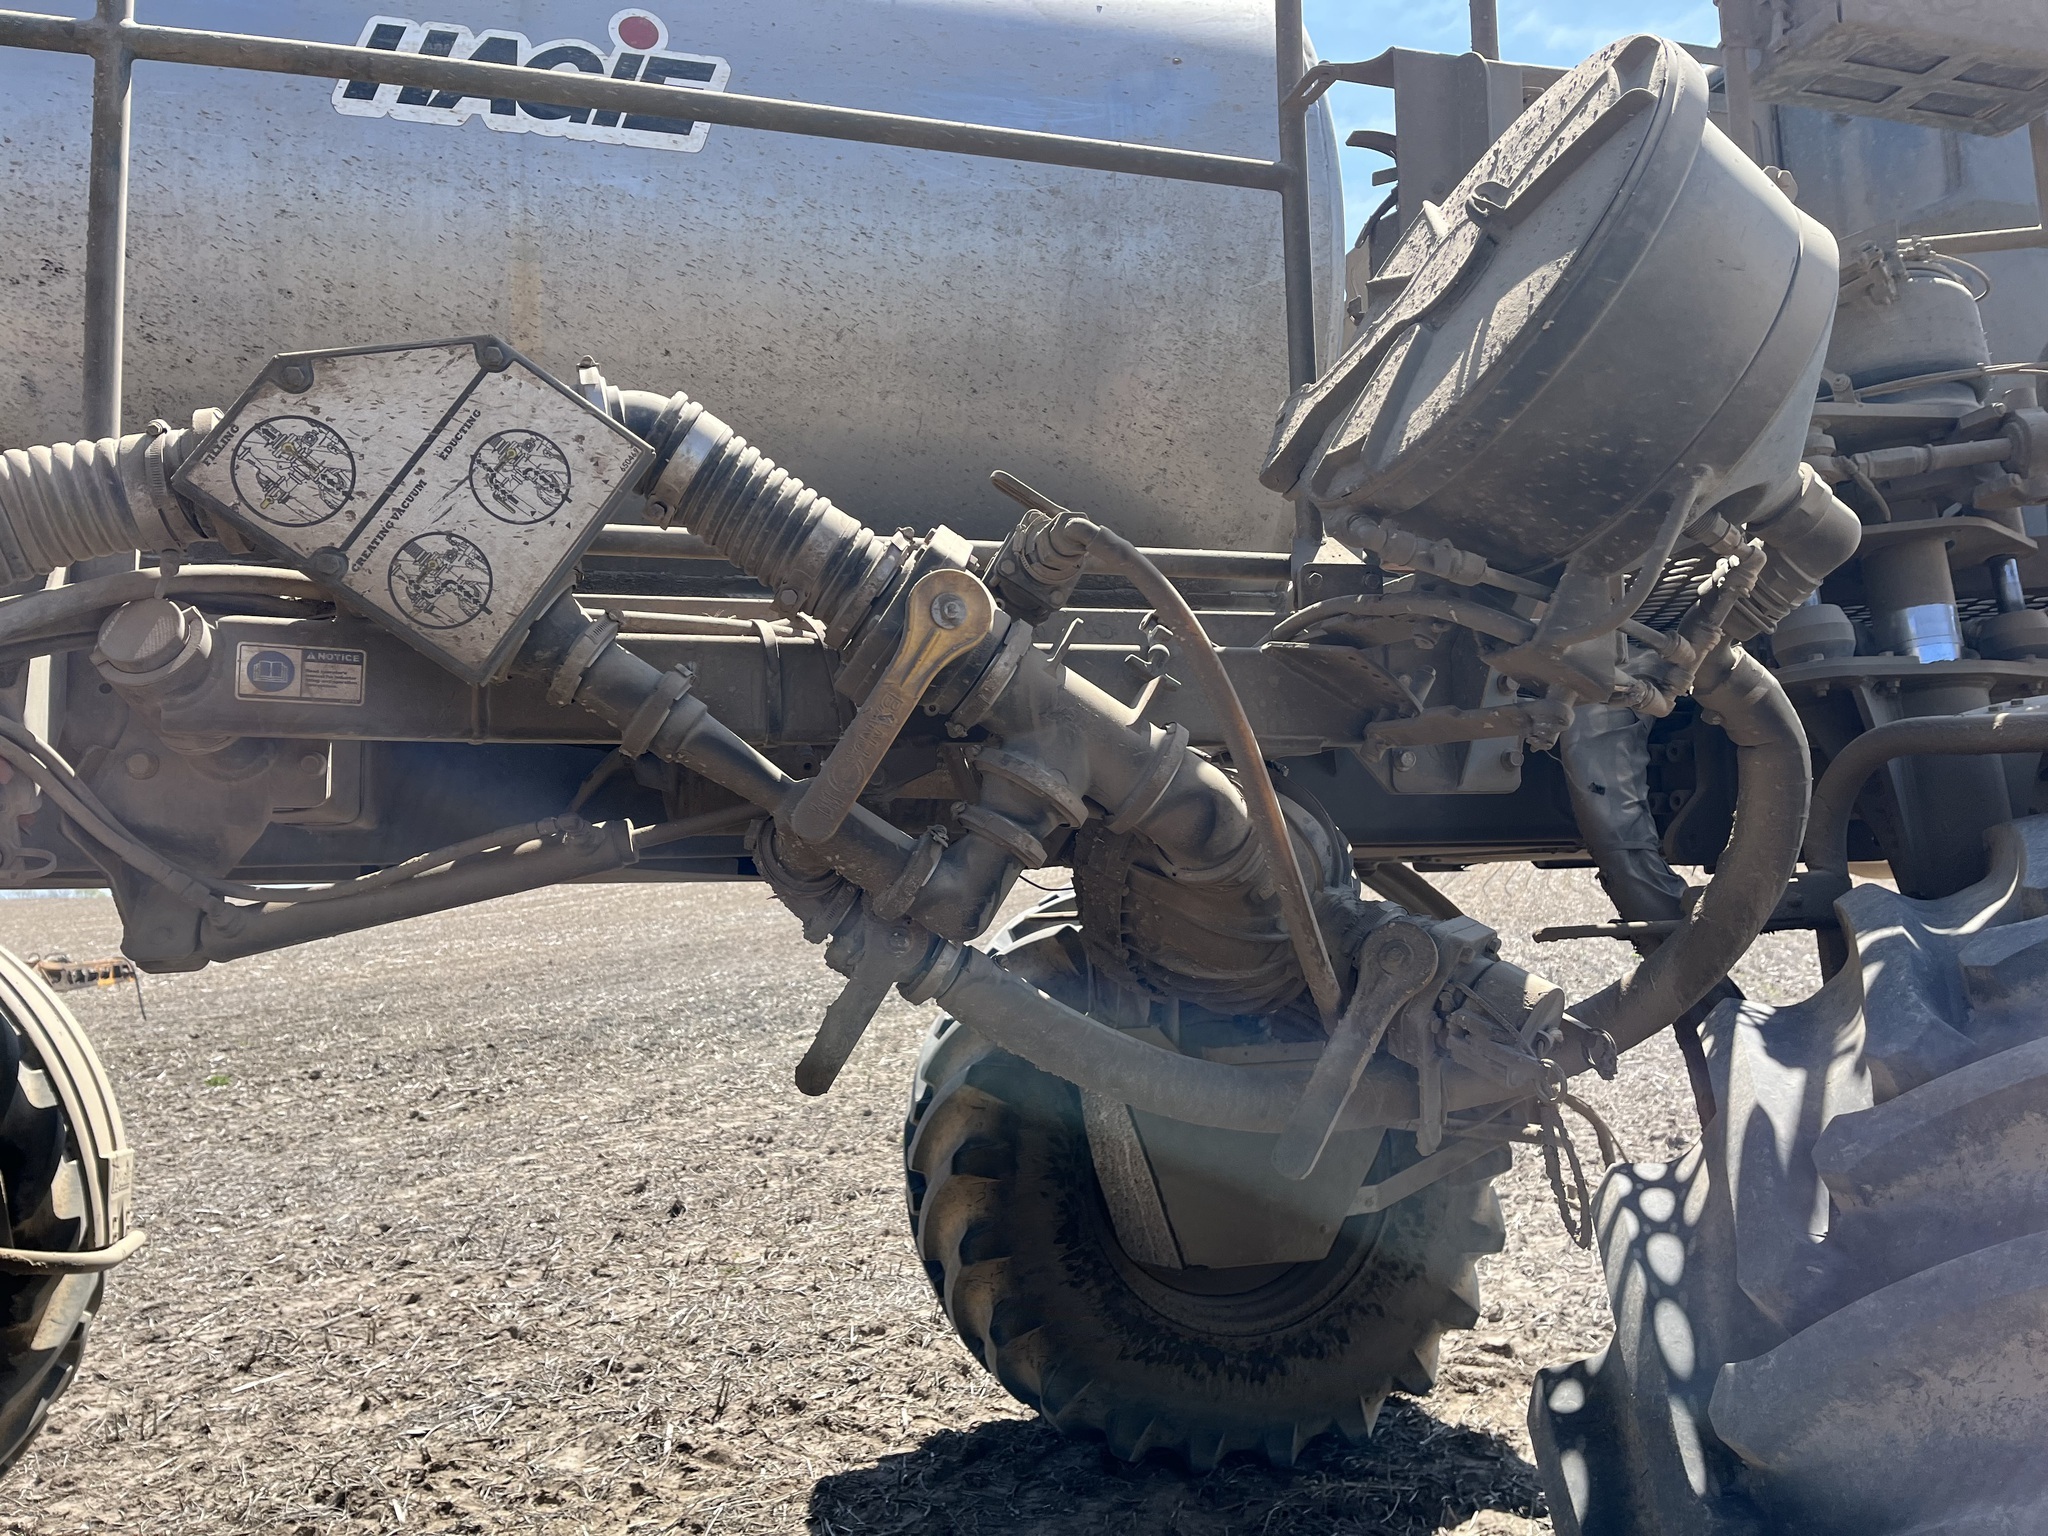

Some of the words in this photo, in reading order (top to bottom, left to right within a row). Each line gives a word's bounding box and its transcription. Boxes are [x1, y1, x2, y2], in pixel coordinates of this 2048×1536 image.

[201, 423, 240, 467] FILLING
[438, 409, 481, 461] EDUCTING
[351, 519, 394, 573] CREATING
[390, 478, 427, 521] VACUUM
[317, 652, 360, 662] NOTICE
